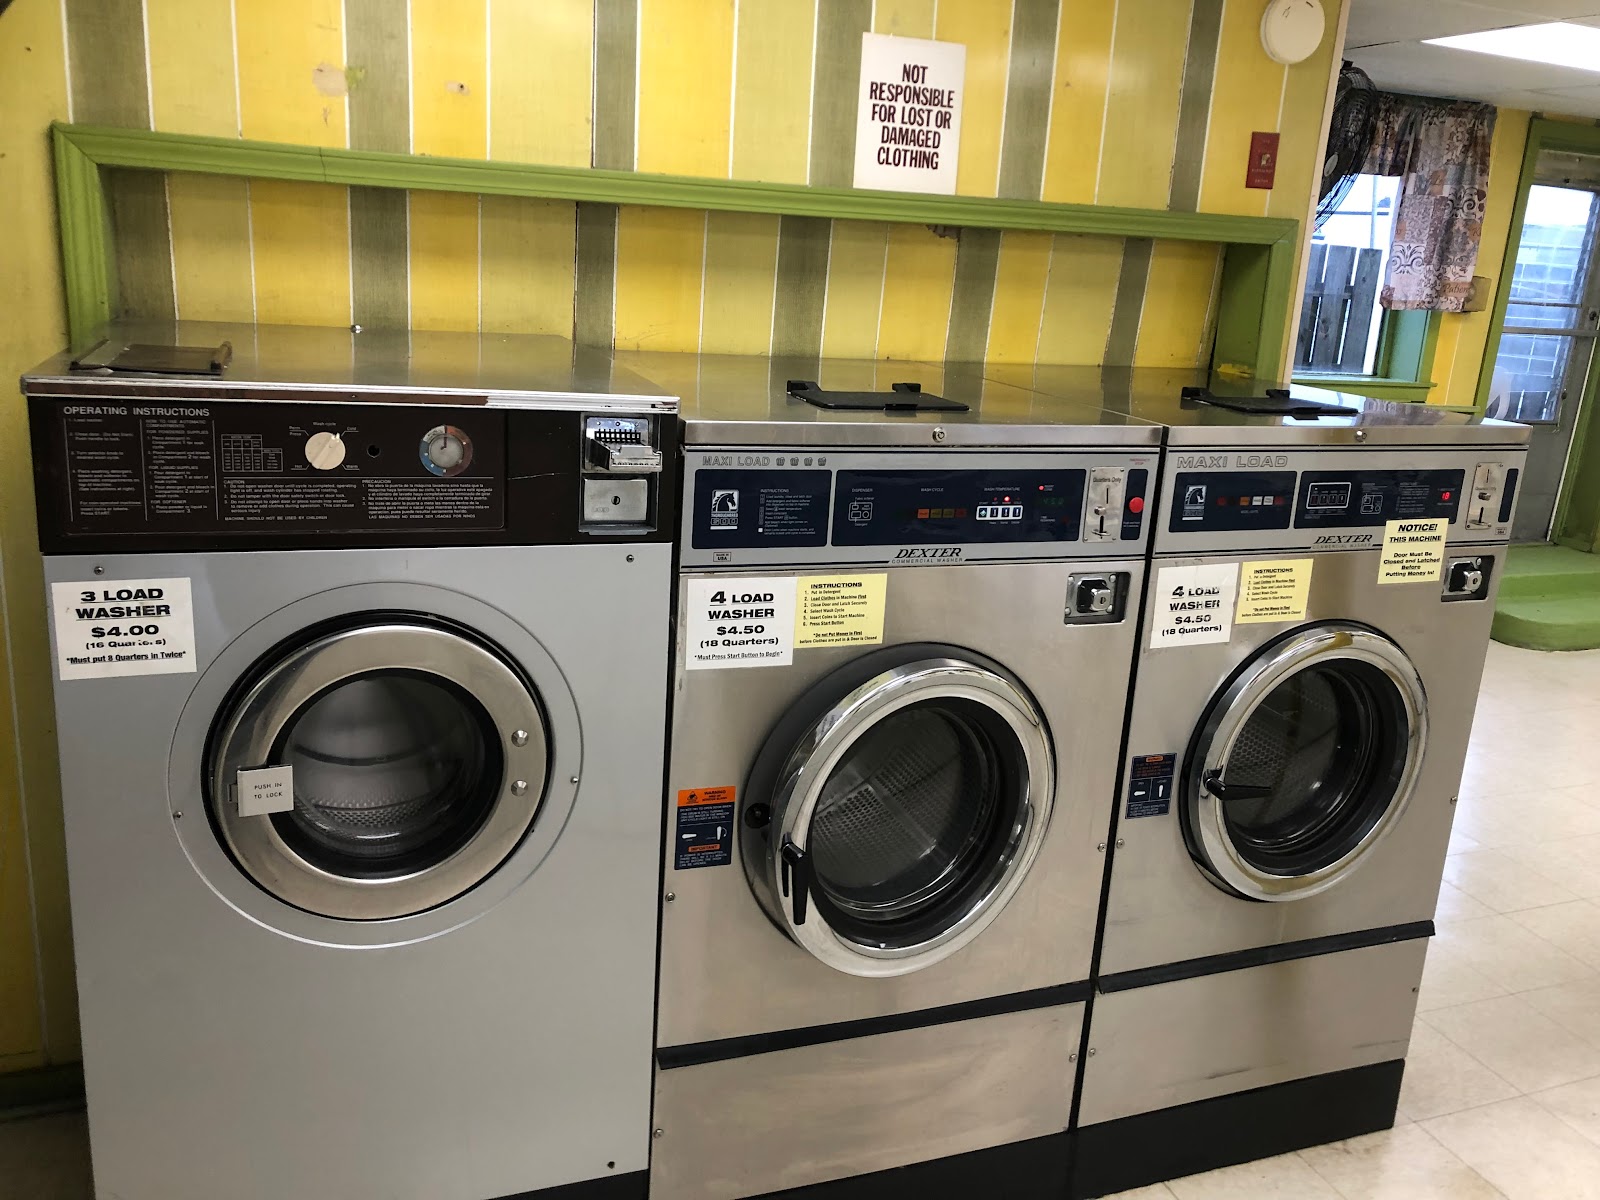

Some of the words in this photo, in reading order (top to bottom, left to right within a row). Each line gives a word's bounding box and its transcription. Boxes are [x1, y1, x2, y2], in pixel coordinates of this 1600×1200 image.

[902, 63, 928, 84] NOT
[869, 81, 955, 109] RESPONSIBLE
[871, 103, 896, 123] FOR
[901, 106, 933, 127] LOST
[935, 111, 952, 129] OR
[881, 125, 941, 149] DAMAGED
[877, 146, 939, 170] CLOTHING
[63, 406, 128, 416] OPERATING
[133, 407, 210, 416] INSTRUCTIONS
[702, 456, 732, 466] MAXI
[737, 456, 770, 466] LOAD
[1177, 456, 1228, 468] MAXI
[1236, 455, 1288, 467] LOAD
[1398, 524, 1438, 532] NOTICE!
[1313, 534, 1373, 544] DEXTER
[894, 547, 962, 558] DEXTER
[80, 591, 96, 602] 3
[103, 588, 164, 601] LOAD
[710, 591, 726, 604] 4
[731, 592, 774, 603] LOAD
[1172, 586, 1184, 597] 4
[1188, 587, 1220, 596] LOAD
[1169, 600, 1220, 611] WASHER
[76, 605, 171, 619] WASHER
[708, 608, 774, 620] WASHER
[1175, 614, 1211, 625] $4.50
[91, 624, 159, 638] $4.00
[716, 624, 765, 636] $4.50
[1162, 628, 1176, 636] (18
[1178, 625, 1222, 634] Quarters)
[86, 641, 105, 650] (16
[108, 638, 166, 648] Quares)
[700, 639, 718, 649] (18
[722, 636, 779, 647] Quarters)
[93, 656, 106, 664] put
[115, 654, 149, 662] Quarters
